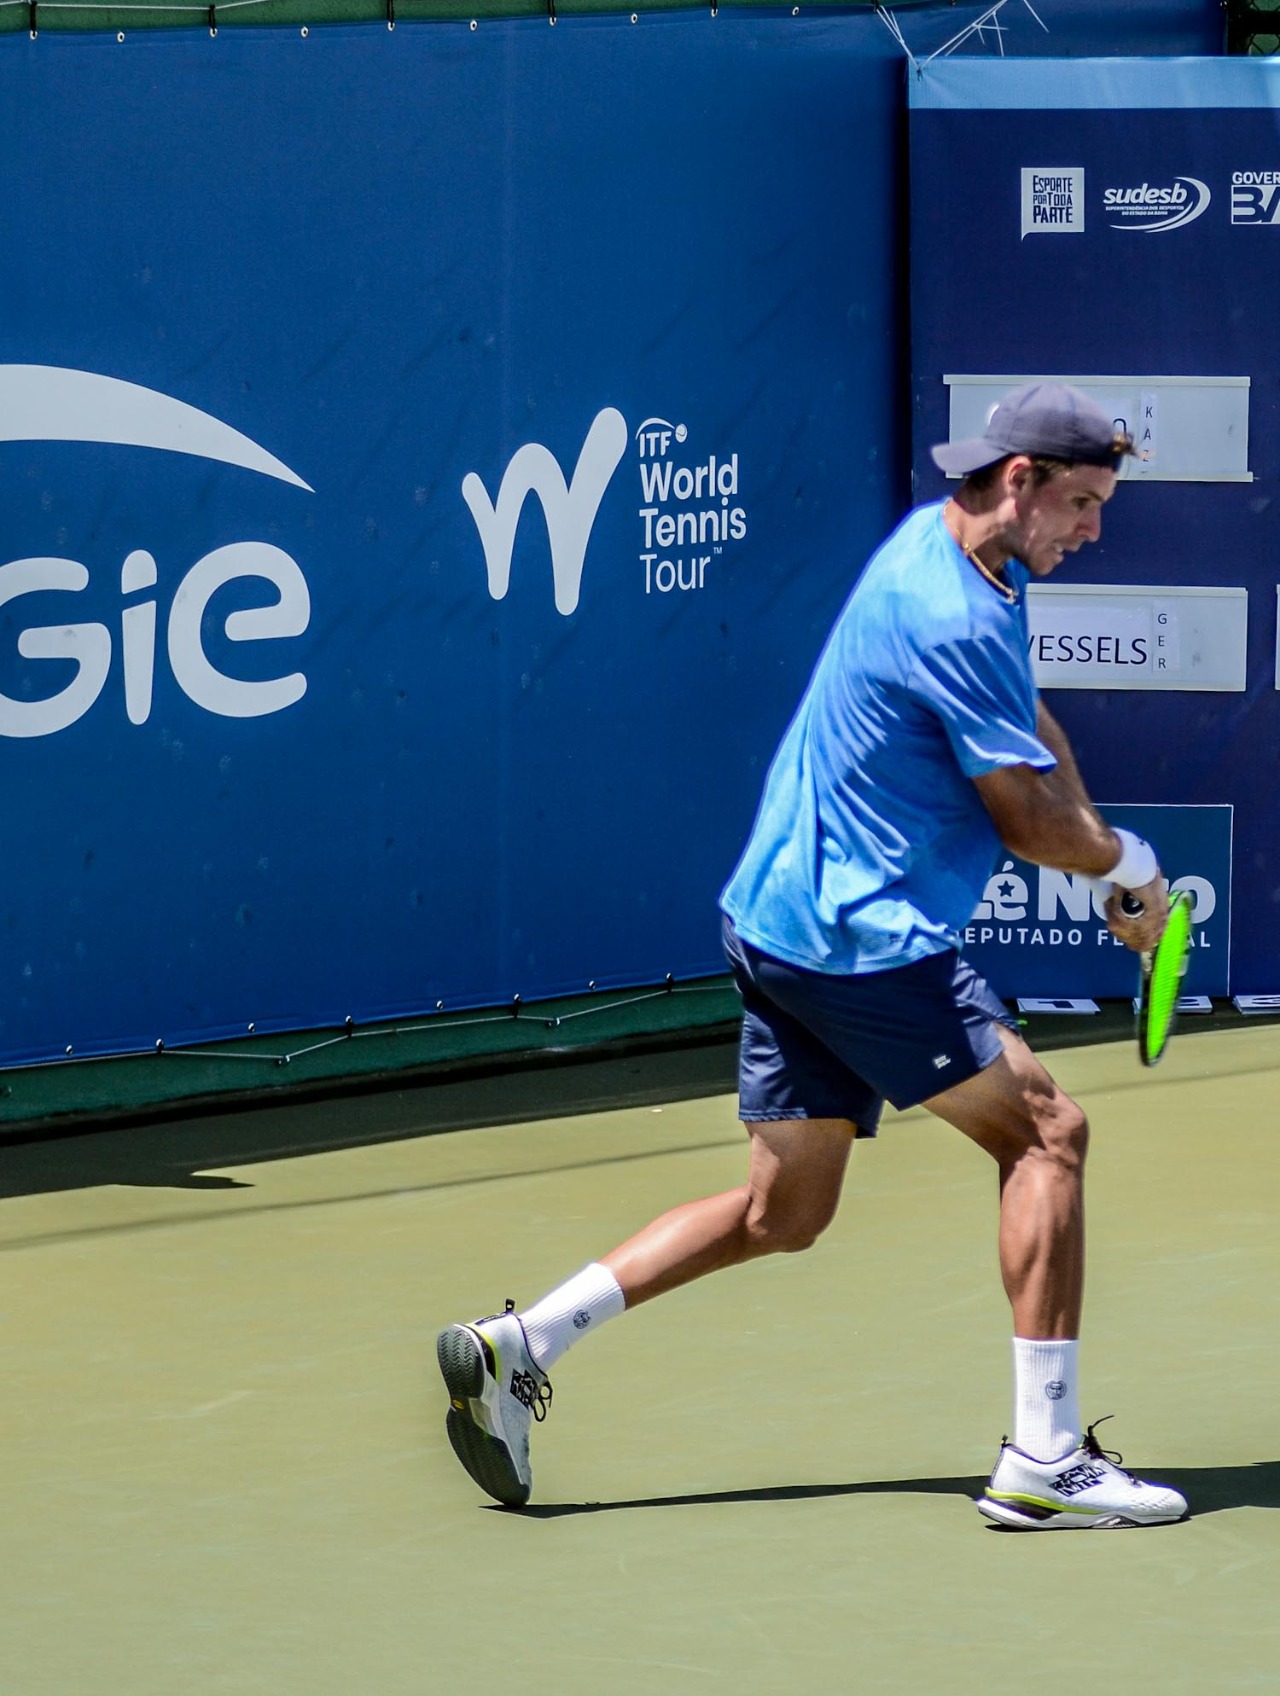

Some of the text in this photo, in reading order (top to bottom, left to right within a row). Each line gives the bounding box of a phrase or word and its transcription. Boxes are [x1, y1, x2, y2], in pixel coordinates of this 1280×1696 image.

[1033, 175, 1073, 193] ESPORTE
[1103, 183, 1188, 204] sudesb
[1033, 192, 1073, 206] POR TODA
[1033, 205, 1073, 223] PARTE
[639, 431, 672, 458] ITF
[639, 453, 738, 503] World
[639, 497, 747, 549] Tennis
[1029, 635, 1148, 665] ESSELS
[1157, 613, 1168, 669] GER
[964, 927, 1083, 945] EPUTADO
